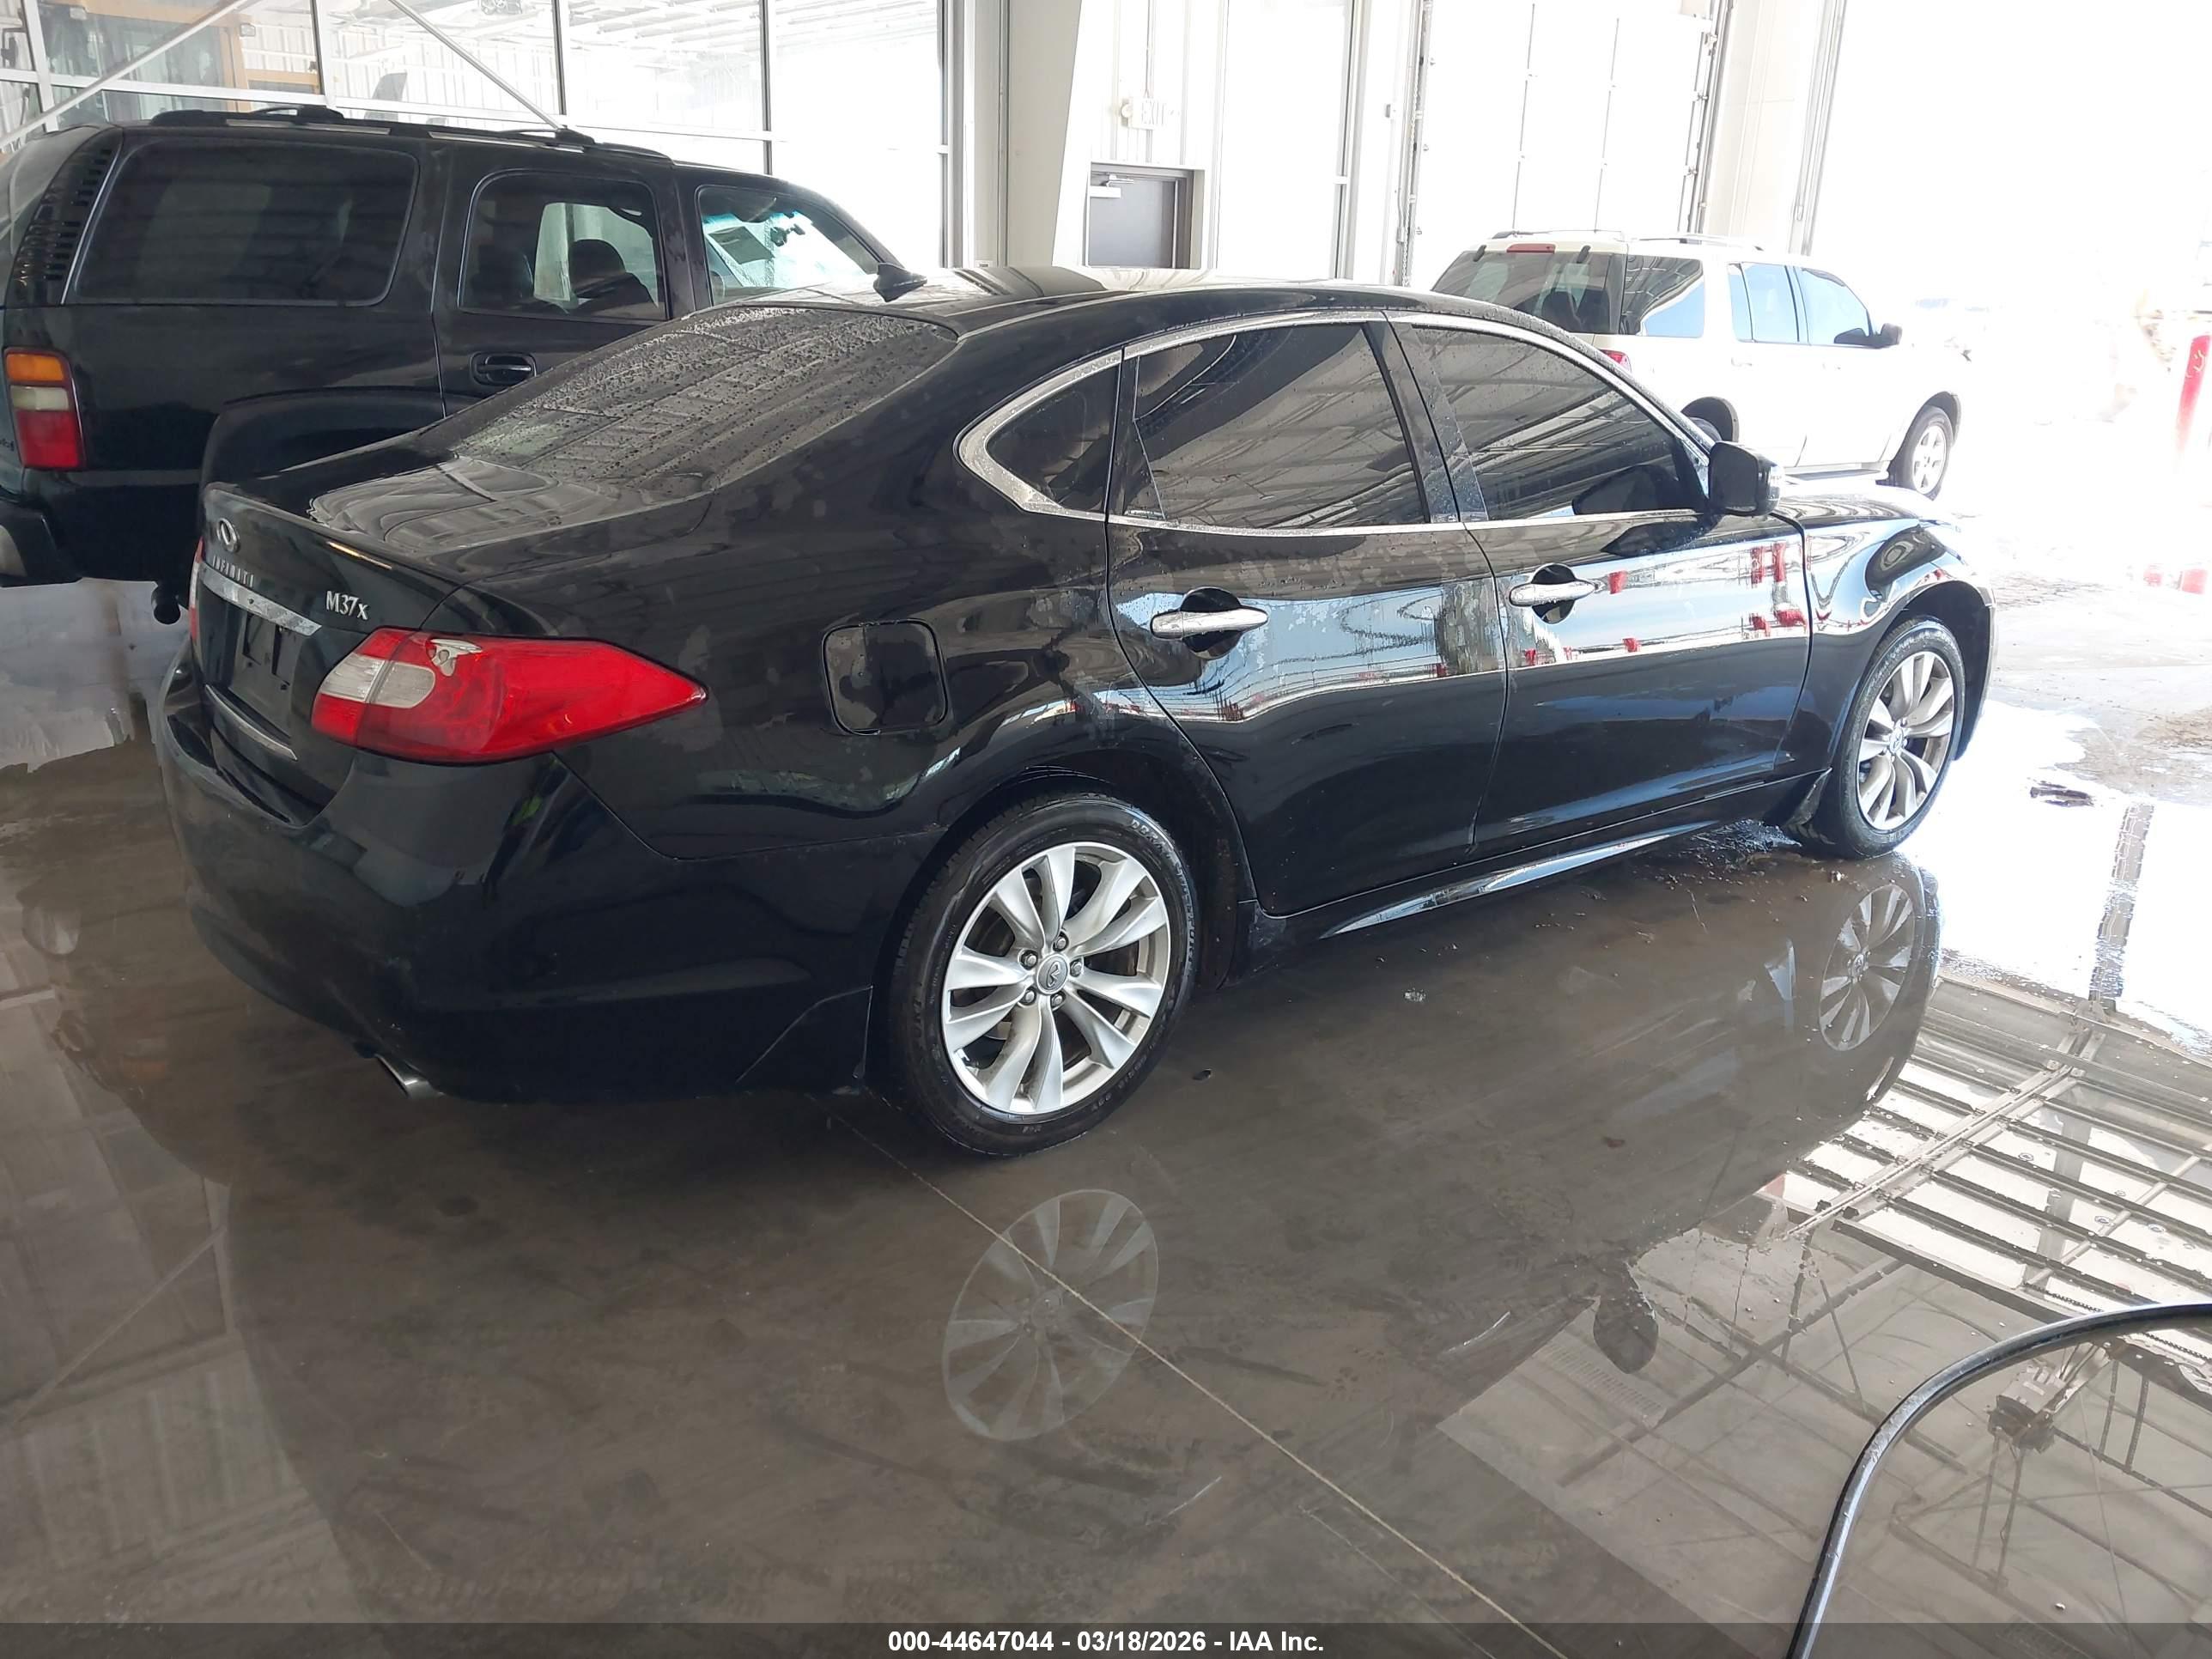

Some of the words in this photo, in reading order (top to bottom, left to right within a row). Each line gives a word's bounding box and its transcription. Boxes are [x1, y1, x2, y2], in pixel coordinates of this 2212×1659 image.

[1140, 100, 1167, 125] EXIT
[212, 555, 254, 588] INFINITI
[325, 590, 368, 620] M37x
